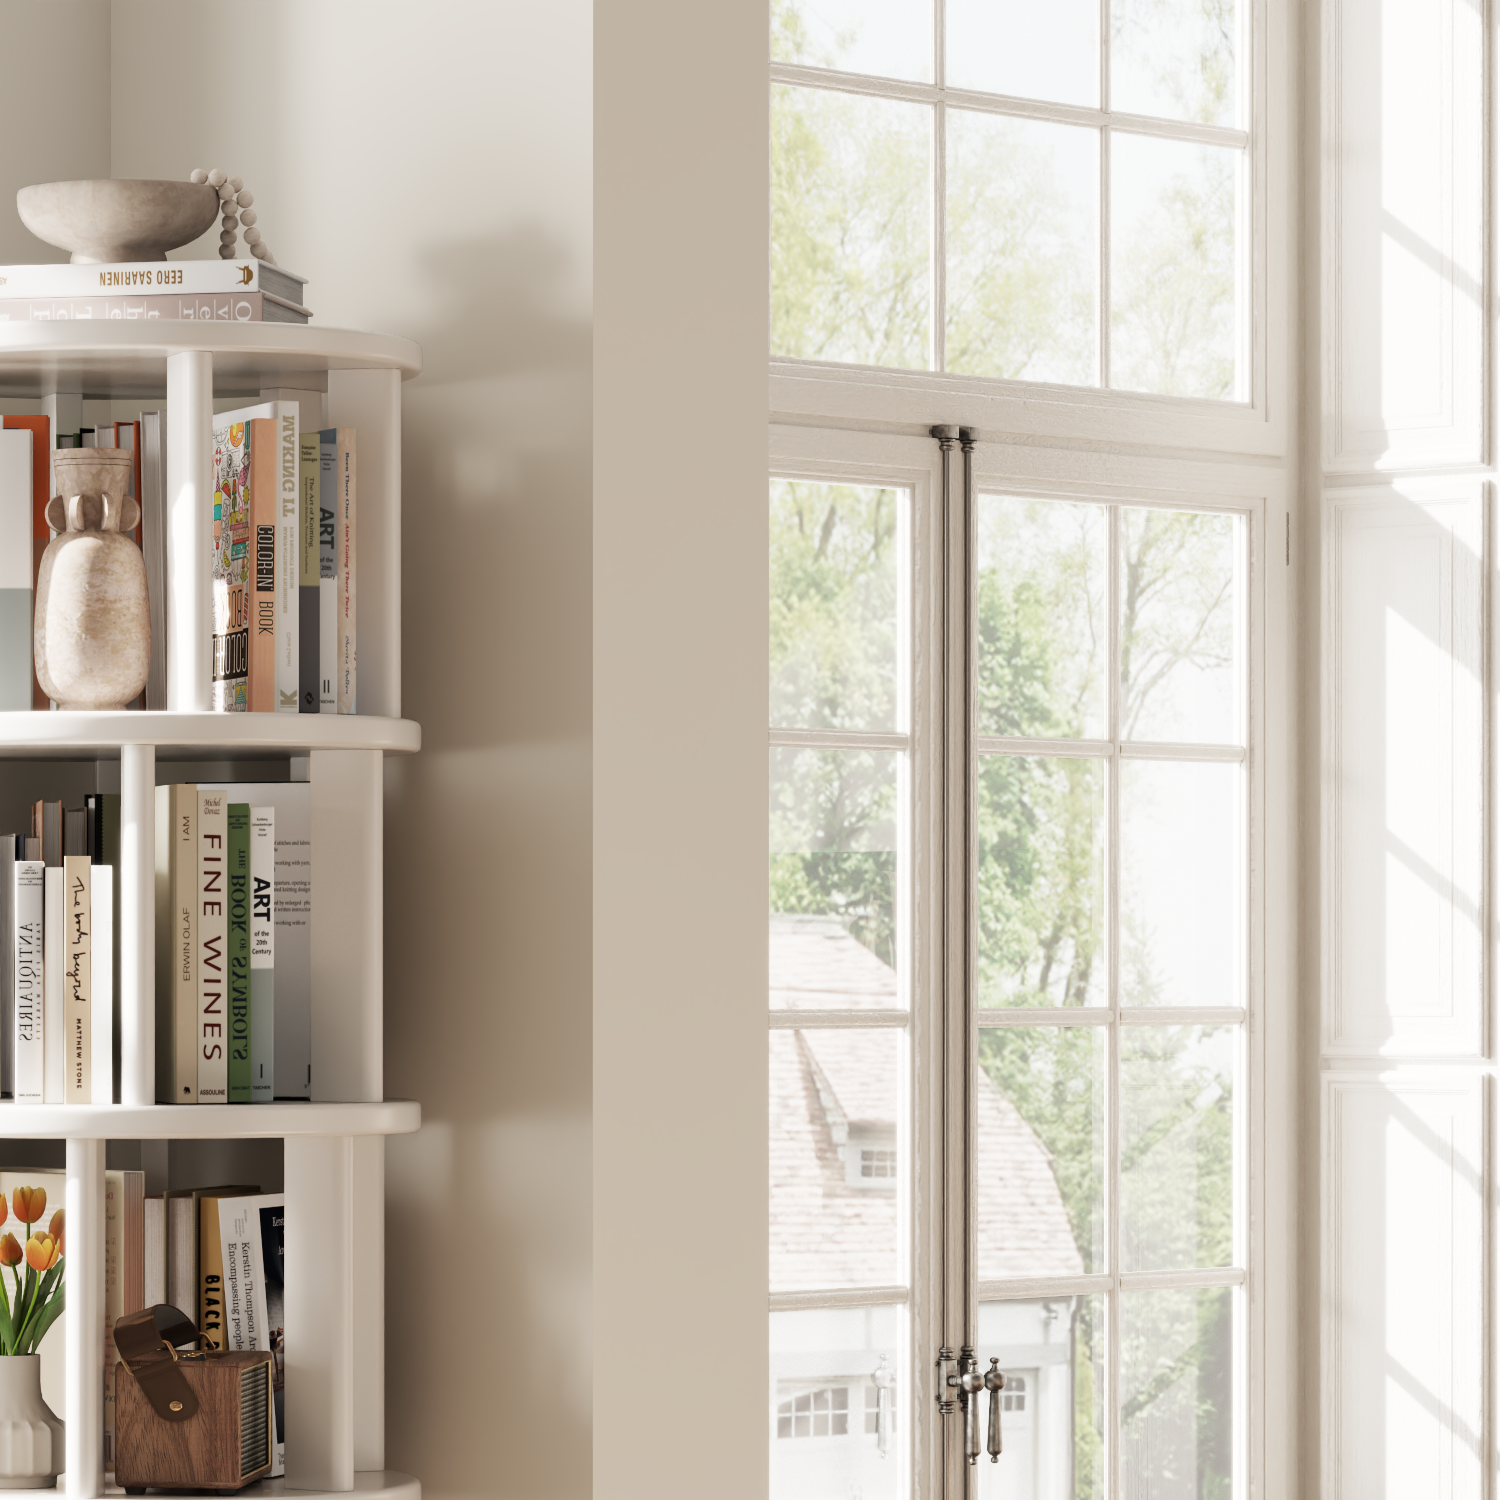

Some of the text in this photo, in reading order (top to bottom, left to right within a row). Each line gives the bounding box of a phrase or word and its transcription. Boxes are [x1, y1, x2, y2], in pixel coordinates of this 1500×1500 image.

[99, 269, 183, 286] EERO SAARINEN
[309, 507, 315, 515] of
[320, 507, 335, 550] ART
[258, 601, 274, 635] BOOK
[203, 797, 222, 808] Michel
[183, 815, 190, 836] AM
[72, 876, 85, 907] The
[253, 876, 271, 922] ART
[203, 834, 222, 1060] FINE WINES
[252, 948, 272, 956] Century
[241, 1242, 253, 1279] Kerstin
[228, 1243, 242, 1315] Encompassing
[205, 1274, 221, 1331] BLACK
[244, 1280, 256, 1334] Thompson
[231, 1316, 245, 1350] people
